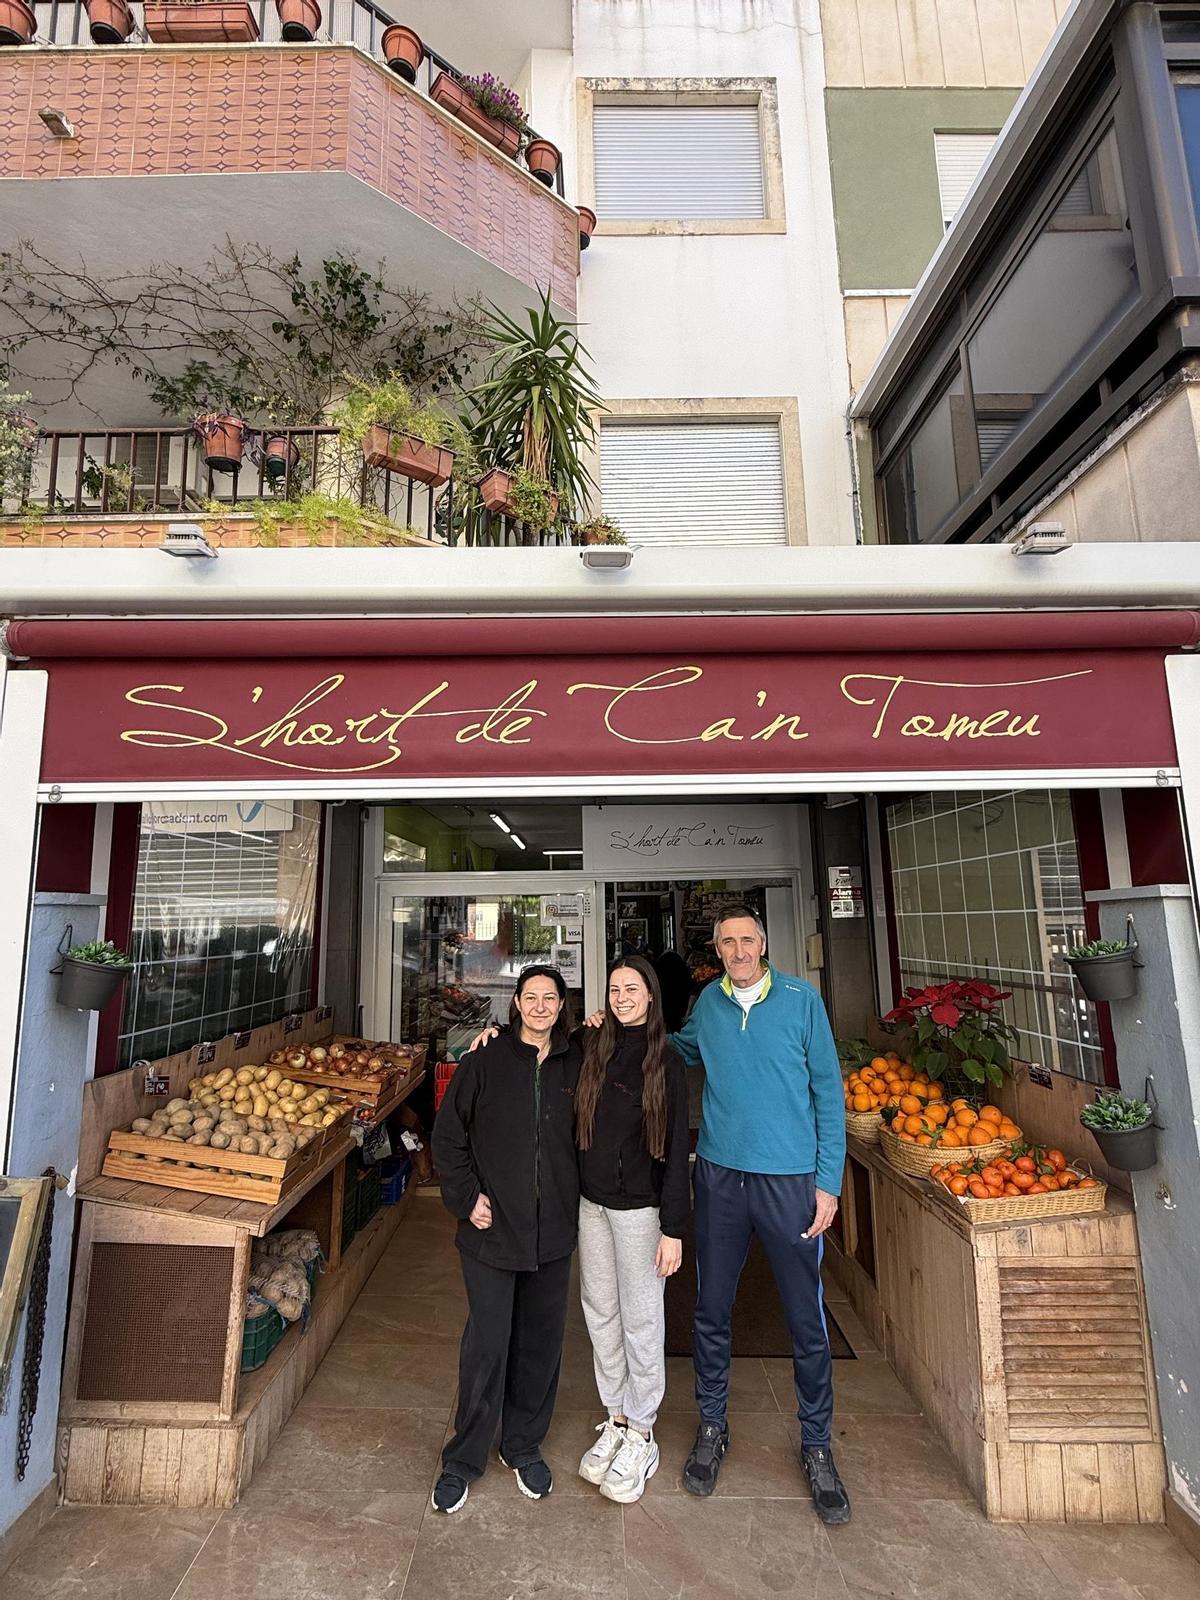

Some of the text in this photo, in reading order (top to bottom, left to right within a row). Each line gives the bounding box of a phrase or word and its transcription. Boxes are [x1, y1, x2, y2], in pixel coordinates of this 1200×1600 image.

[119, 665, 1093, 773] S'hort de Ca'n Tomeu
[610, 822, 775, 856] S'hort de Ca'n Tomeu
